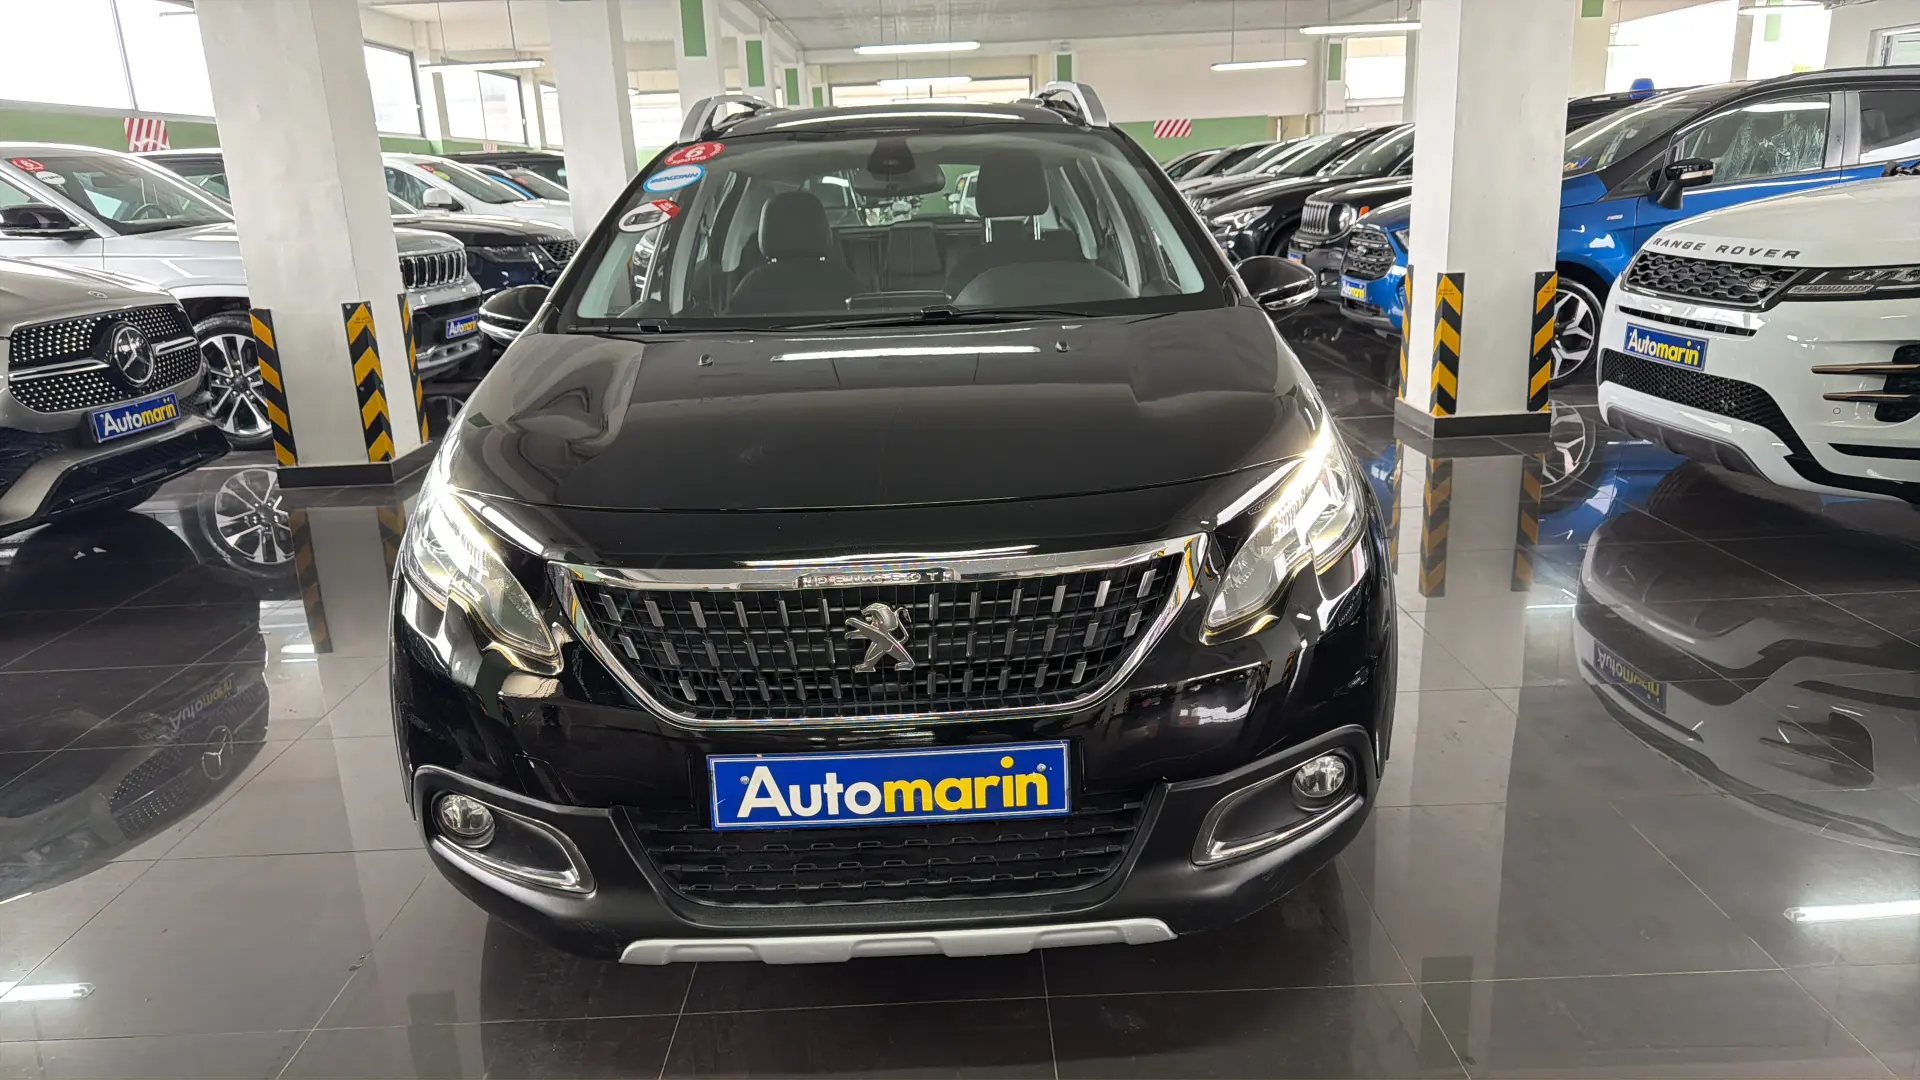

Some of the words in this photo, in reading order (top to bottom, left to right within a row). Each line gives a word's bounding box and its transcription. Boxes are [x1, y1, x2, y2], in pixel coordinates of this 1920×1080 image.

[685, 146, 706, 158] 6
[1652, 237, 1706, 251] RANGE
[1715, 244, 1801, 260] ROVER
[1627, 328, 1699, 366] Automarin
[104, 397, 177, 437] Automarin
[736, 756, 1048, 818] Automarin
